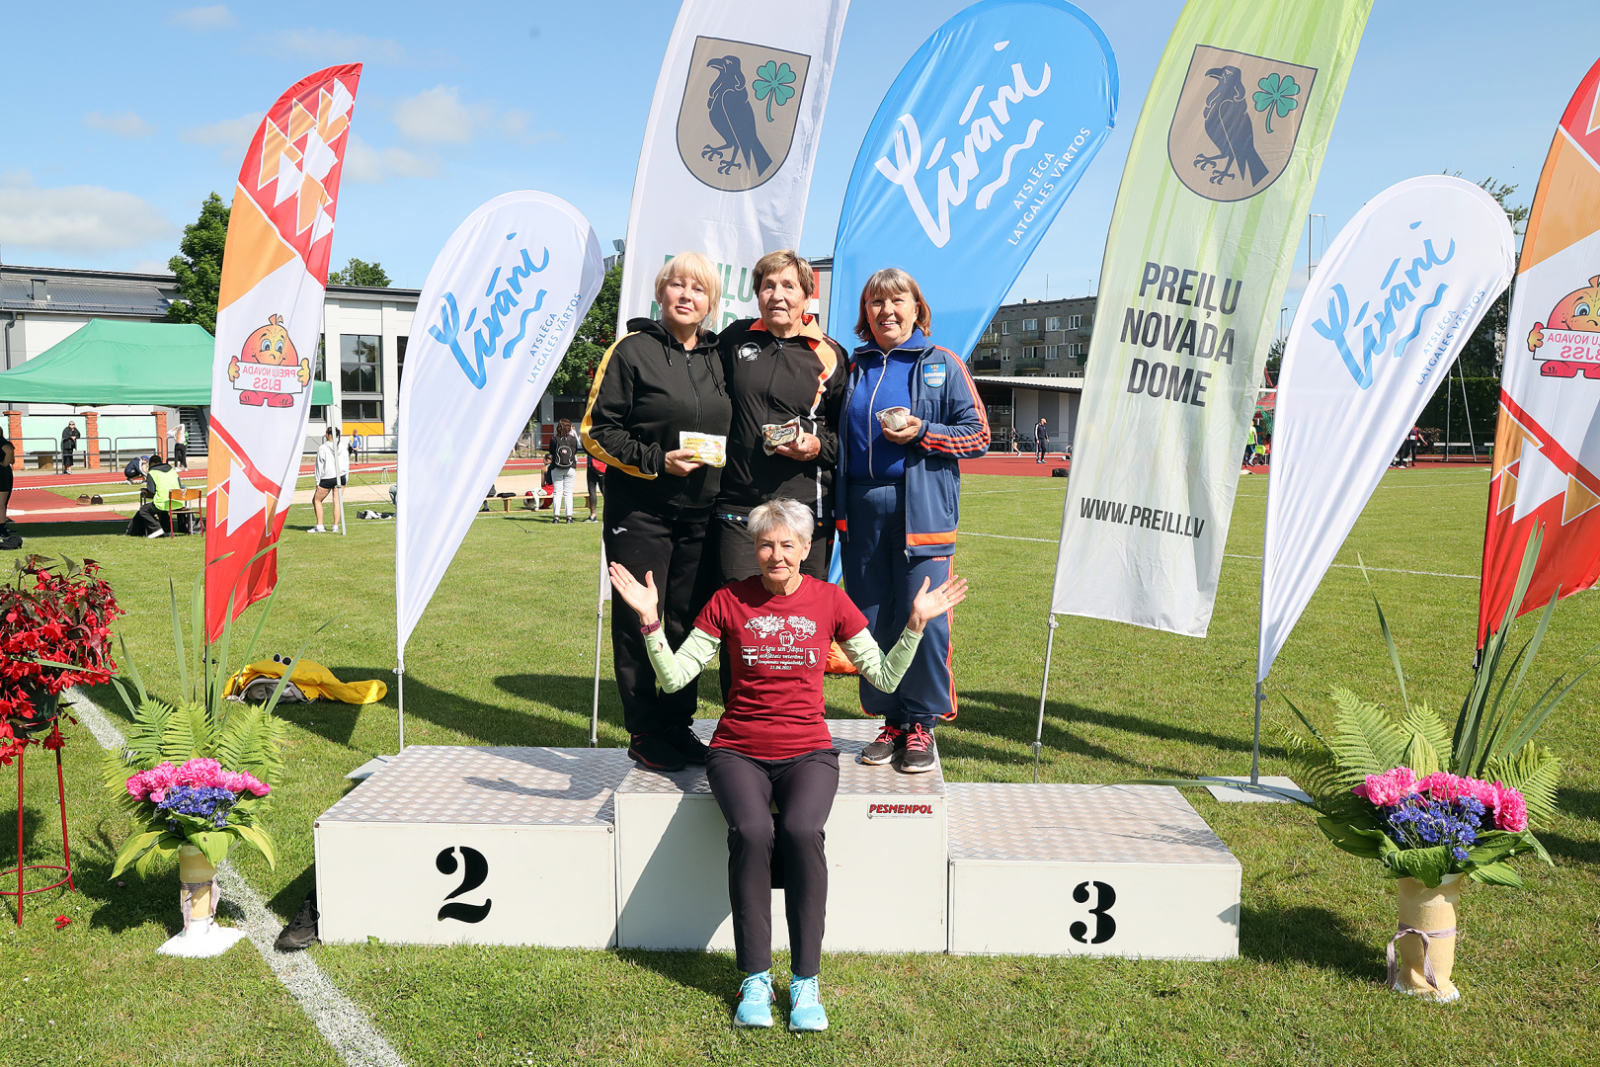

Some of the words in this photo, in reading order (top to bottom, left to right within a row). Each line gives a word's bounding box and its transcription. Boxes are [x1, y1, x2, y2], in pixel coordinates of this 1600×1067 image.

[1007, 183, 1054, 246] LATGALES
[1051, 127, 1091, 178] VĀRTOS
[1015, 152, 1055, 210] ATSLĒGA
[1138, 261, 1243, 318] PREIĻU
[527, 335, 559, 384] LATGALES
[555, 292, 582, 333] VĀRTOS
[529, 312, 557, 357] ATSLĒGA
[1120, 307, 1236, 365] NOVADA
[1416, 333, 1455, 385] LATGALES
[1451, 289, 1486, 330] VĀRTOS
[1423, 309, 1457, 357] ATSLĒGA
[1126, 358, 1213, 407] DOME
[1080, 497, 1205, 539] WWW.PREILI.LV
[869, 804, 933, 814] PESMENPOL
[435, 845, 492, 924] 2
[1069, 880, 1117, 944] 3
